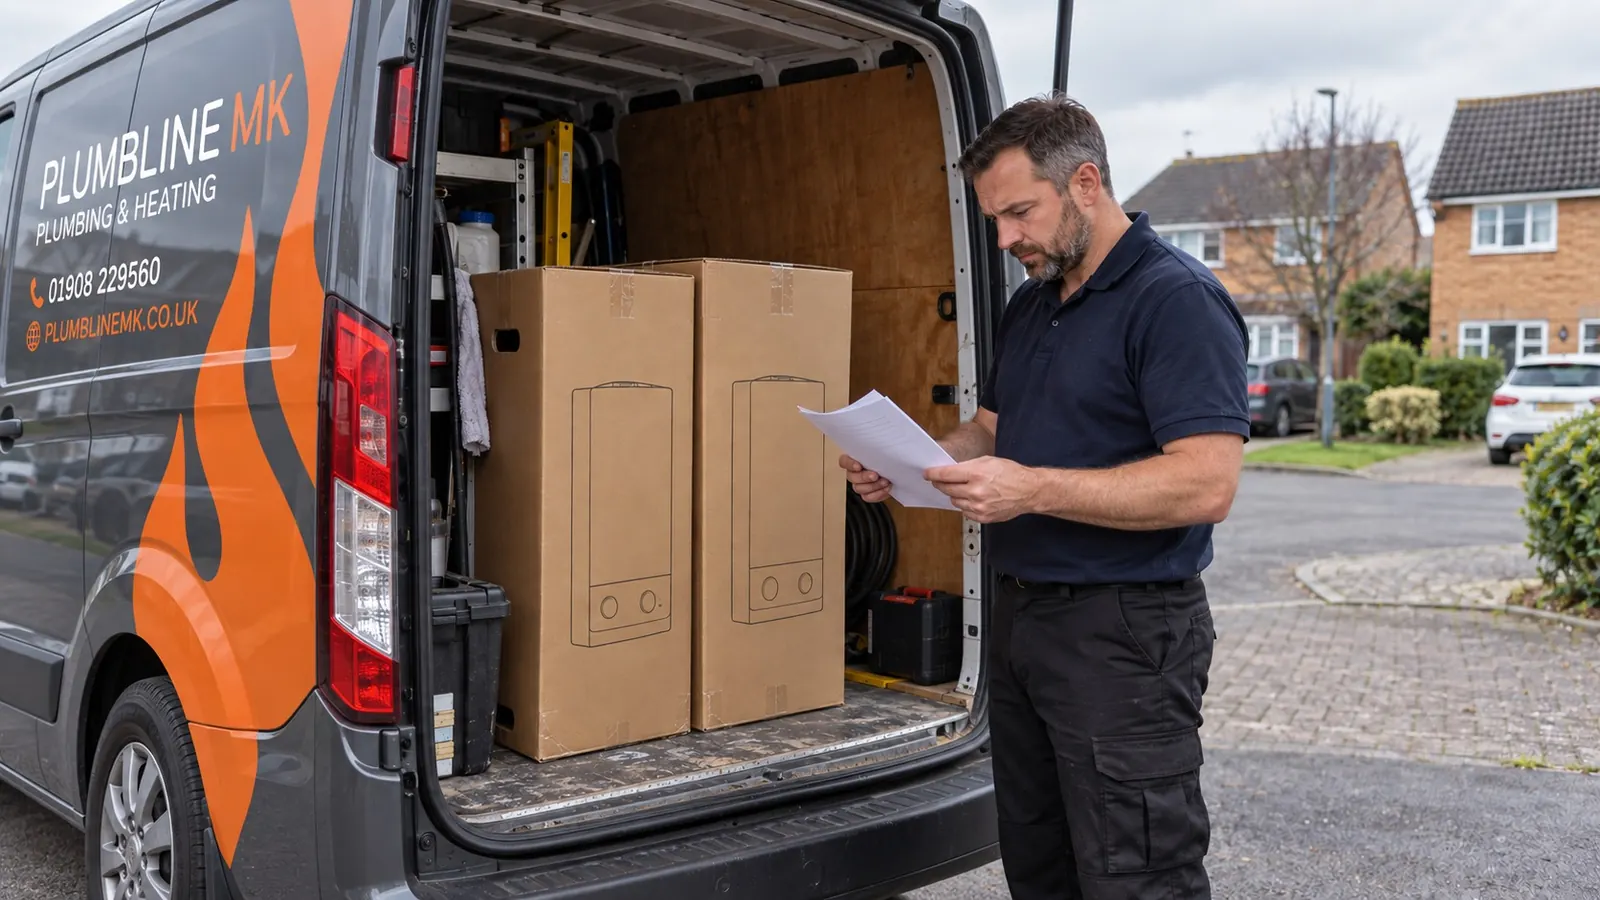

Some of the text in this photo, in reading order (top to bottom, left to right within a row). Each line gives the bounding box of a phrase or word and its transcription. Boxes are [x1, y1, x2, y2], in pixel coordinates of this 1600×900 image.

[40, 73, 293, 209] PLUMBLINE MK
[36, 174, 217, 246] PLUMBING & HEATING
[48, 256, 161, 303] 01908 229560
[45, 300, 199, 343] PLUMBLINEMK.CO.UK
